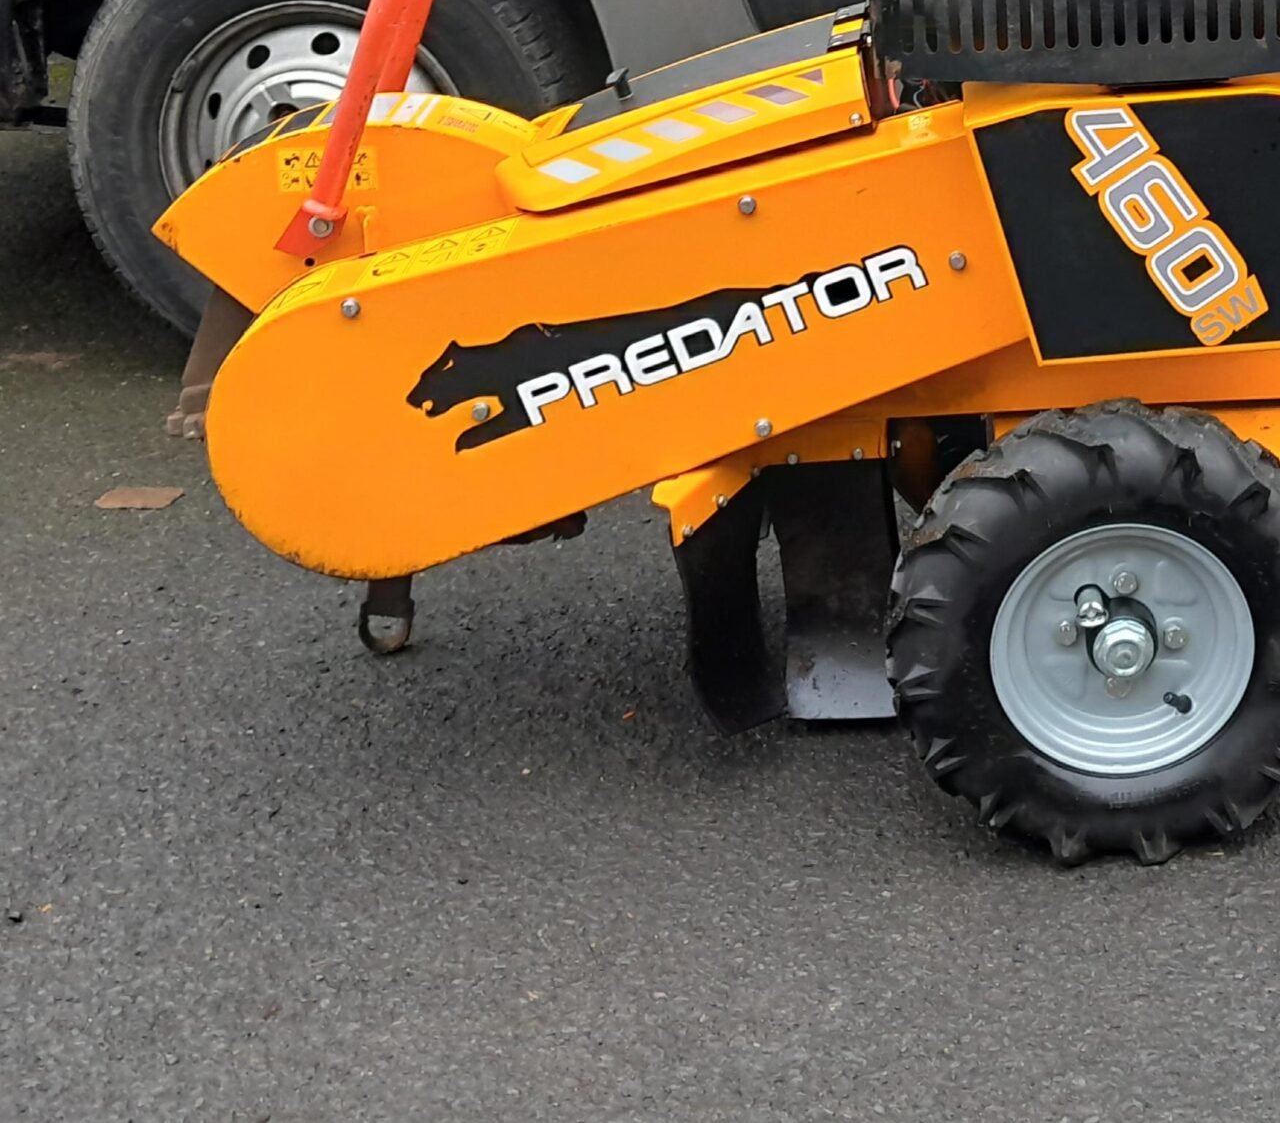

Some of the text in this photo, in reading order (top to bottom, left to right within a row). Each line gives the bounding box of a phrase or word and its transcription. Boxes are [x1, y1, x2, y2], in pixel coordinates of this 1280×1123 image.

[1071, 108, 1239, 312] 460
[515, 245, 929, 427] PREDATOR
[1194, 284, 1259, 342] SW
